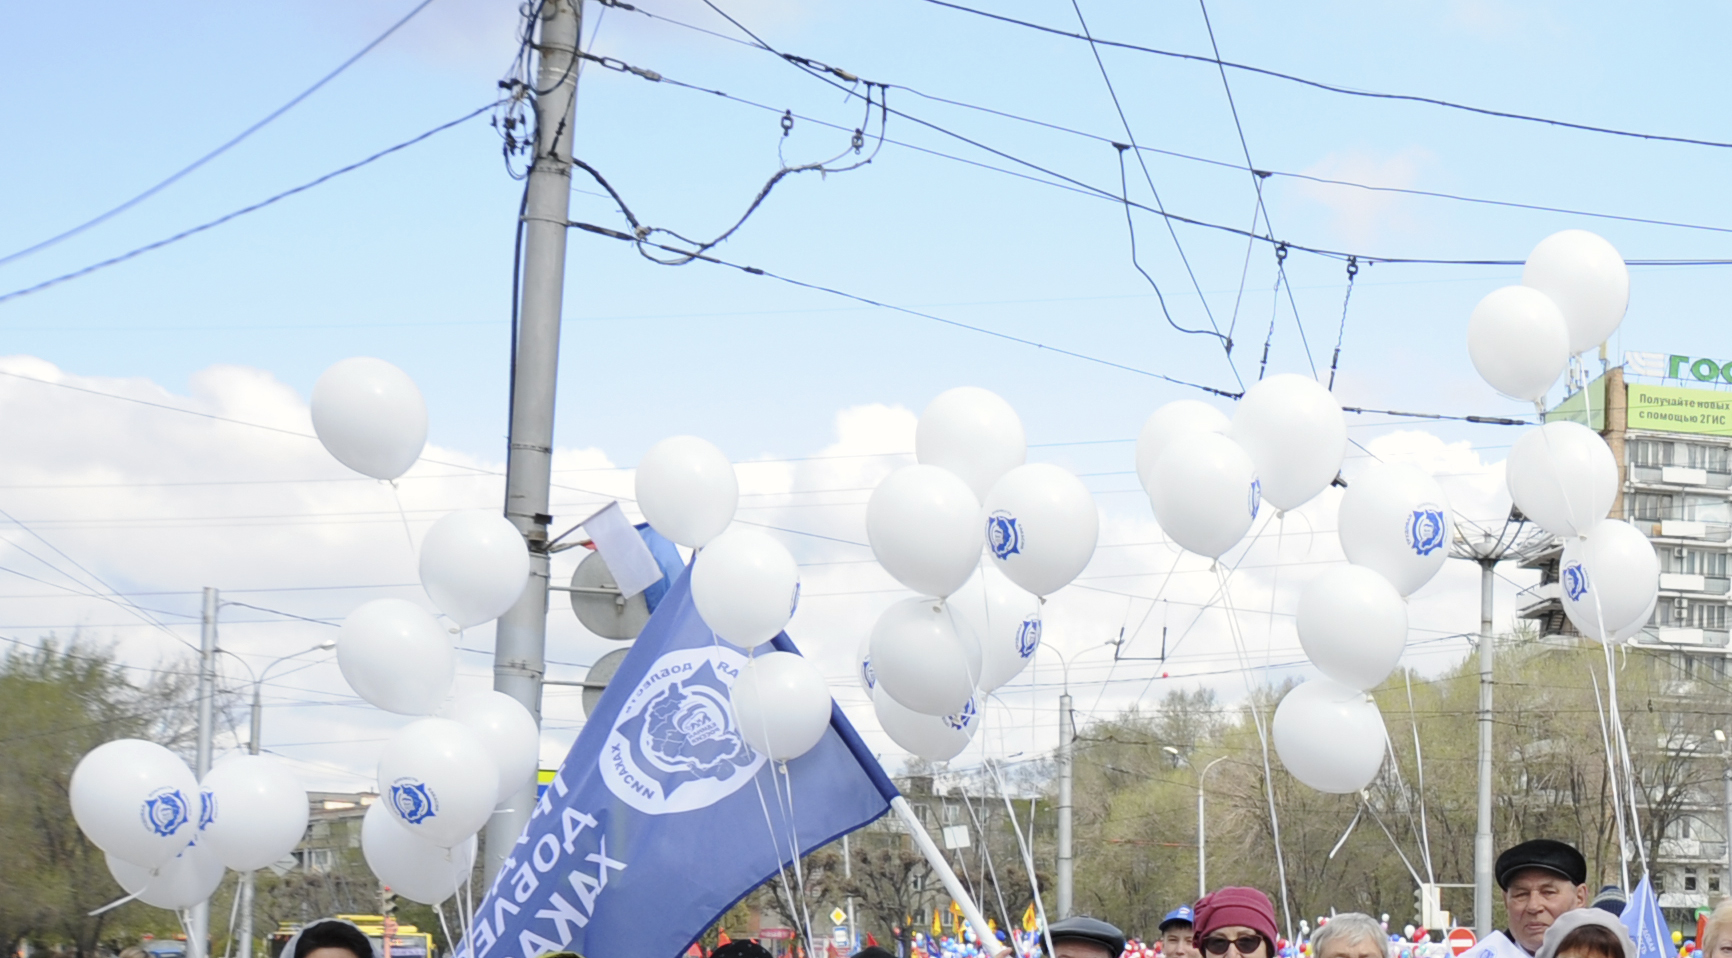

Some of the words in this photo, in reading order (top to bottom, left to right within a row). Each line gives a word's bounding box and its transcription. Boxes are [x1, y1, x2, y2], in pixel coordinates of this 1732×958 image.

[1640, 393, 1695, 407] Получайте
[1697, 401, 1730, 411] новых
[1647, 412, 1698, 423] помощью
[1700, 414, 1726, 425] 2ГИС
